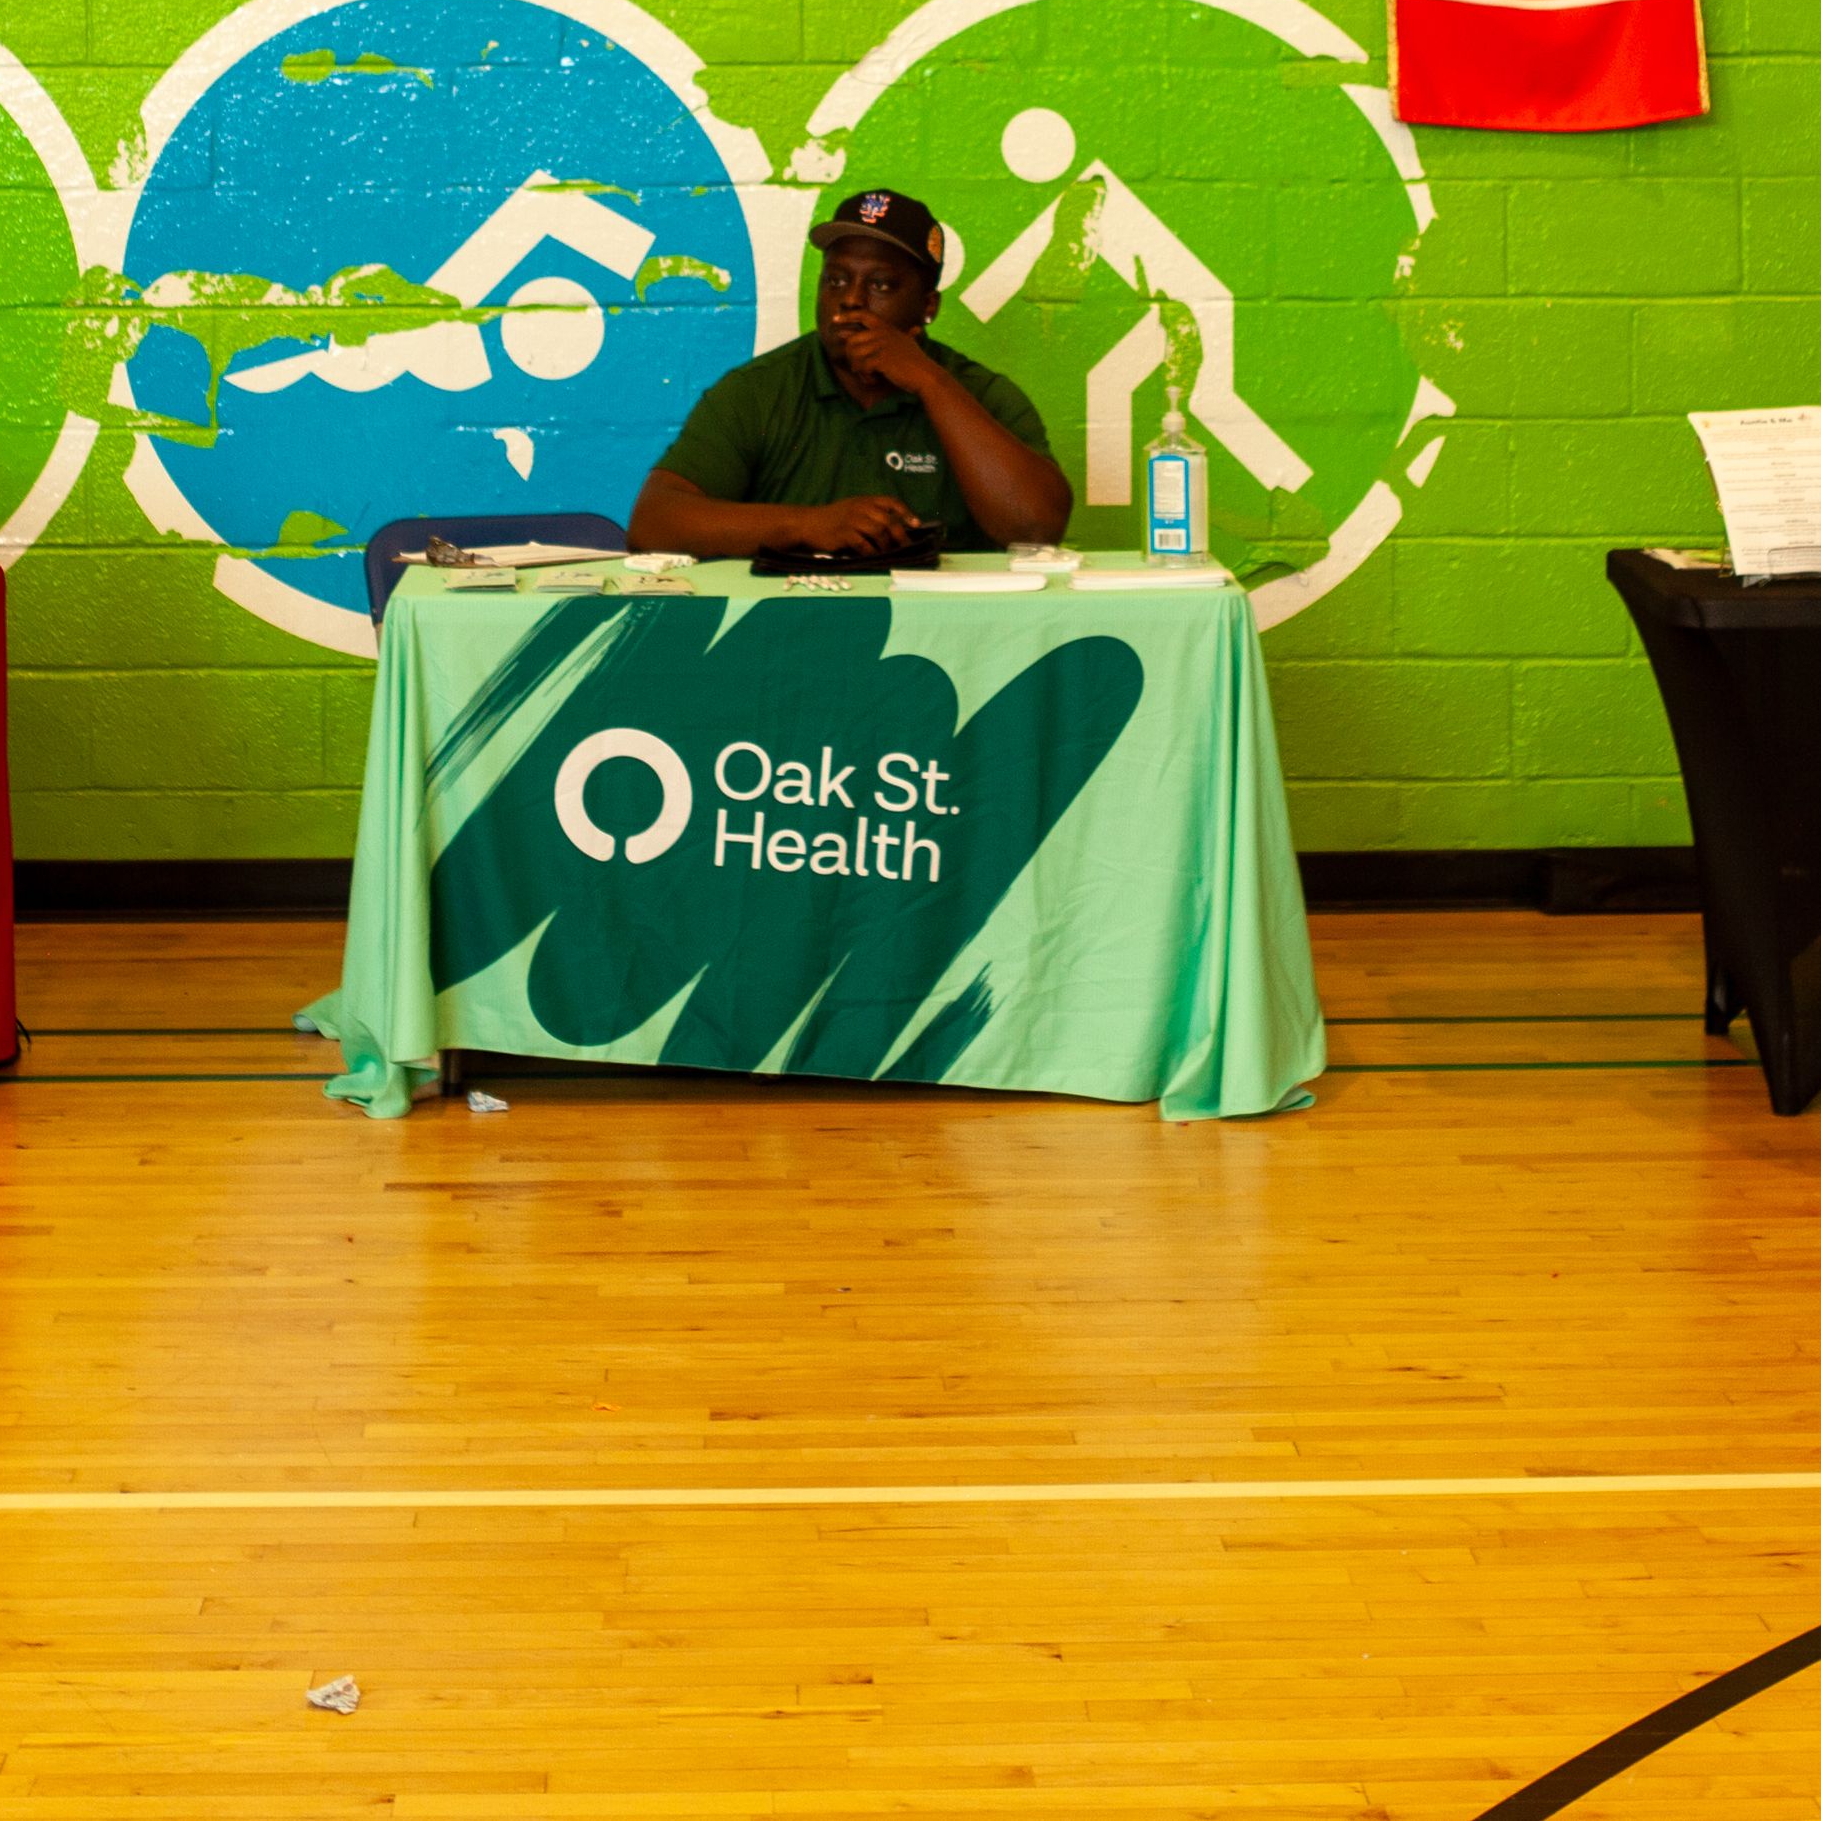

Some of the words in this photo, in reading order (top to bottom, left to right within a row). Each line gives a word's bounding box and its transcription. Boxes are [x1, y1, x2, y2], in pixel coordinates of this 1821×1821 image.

[714, 741, 857, 809] Oak
[874, 752, 961, 815] St.
[714, 808, 941, 883] Health
